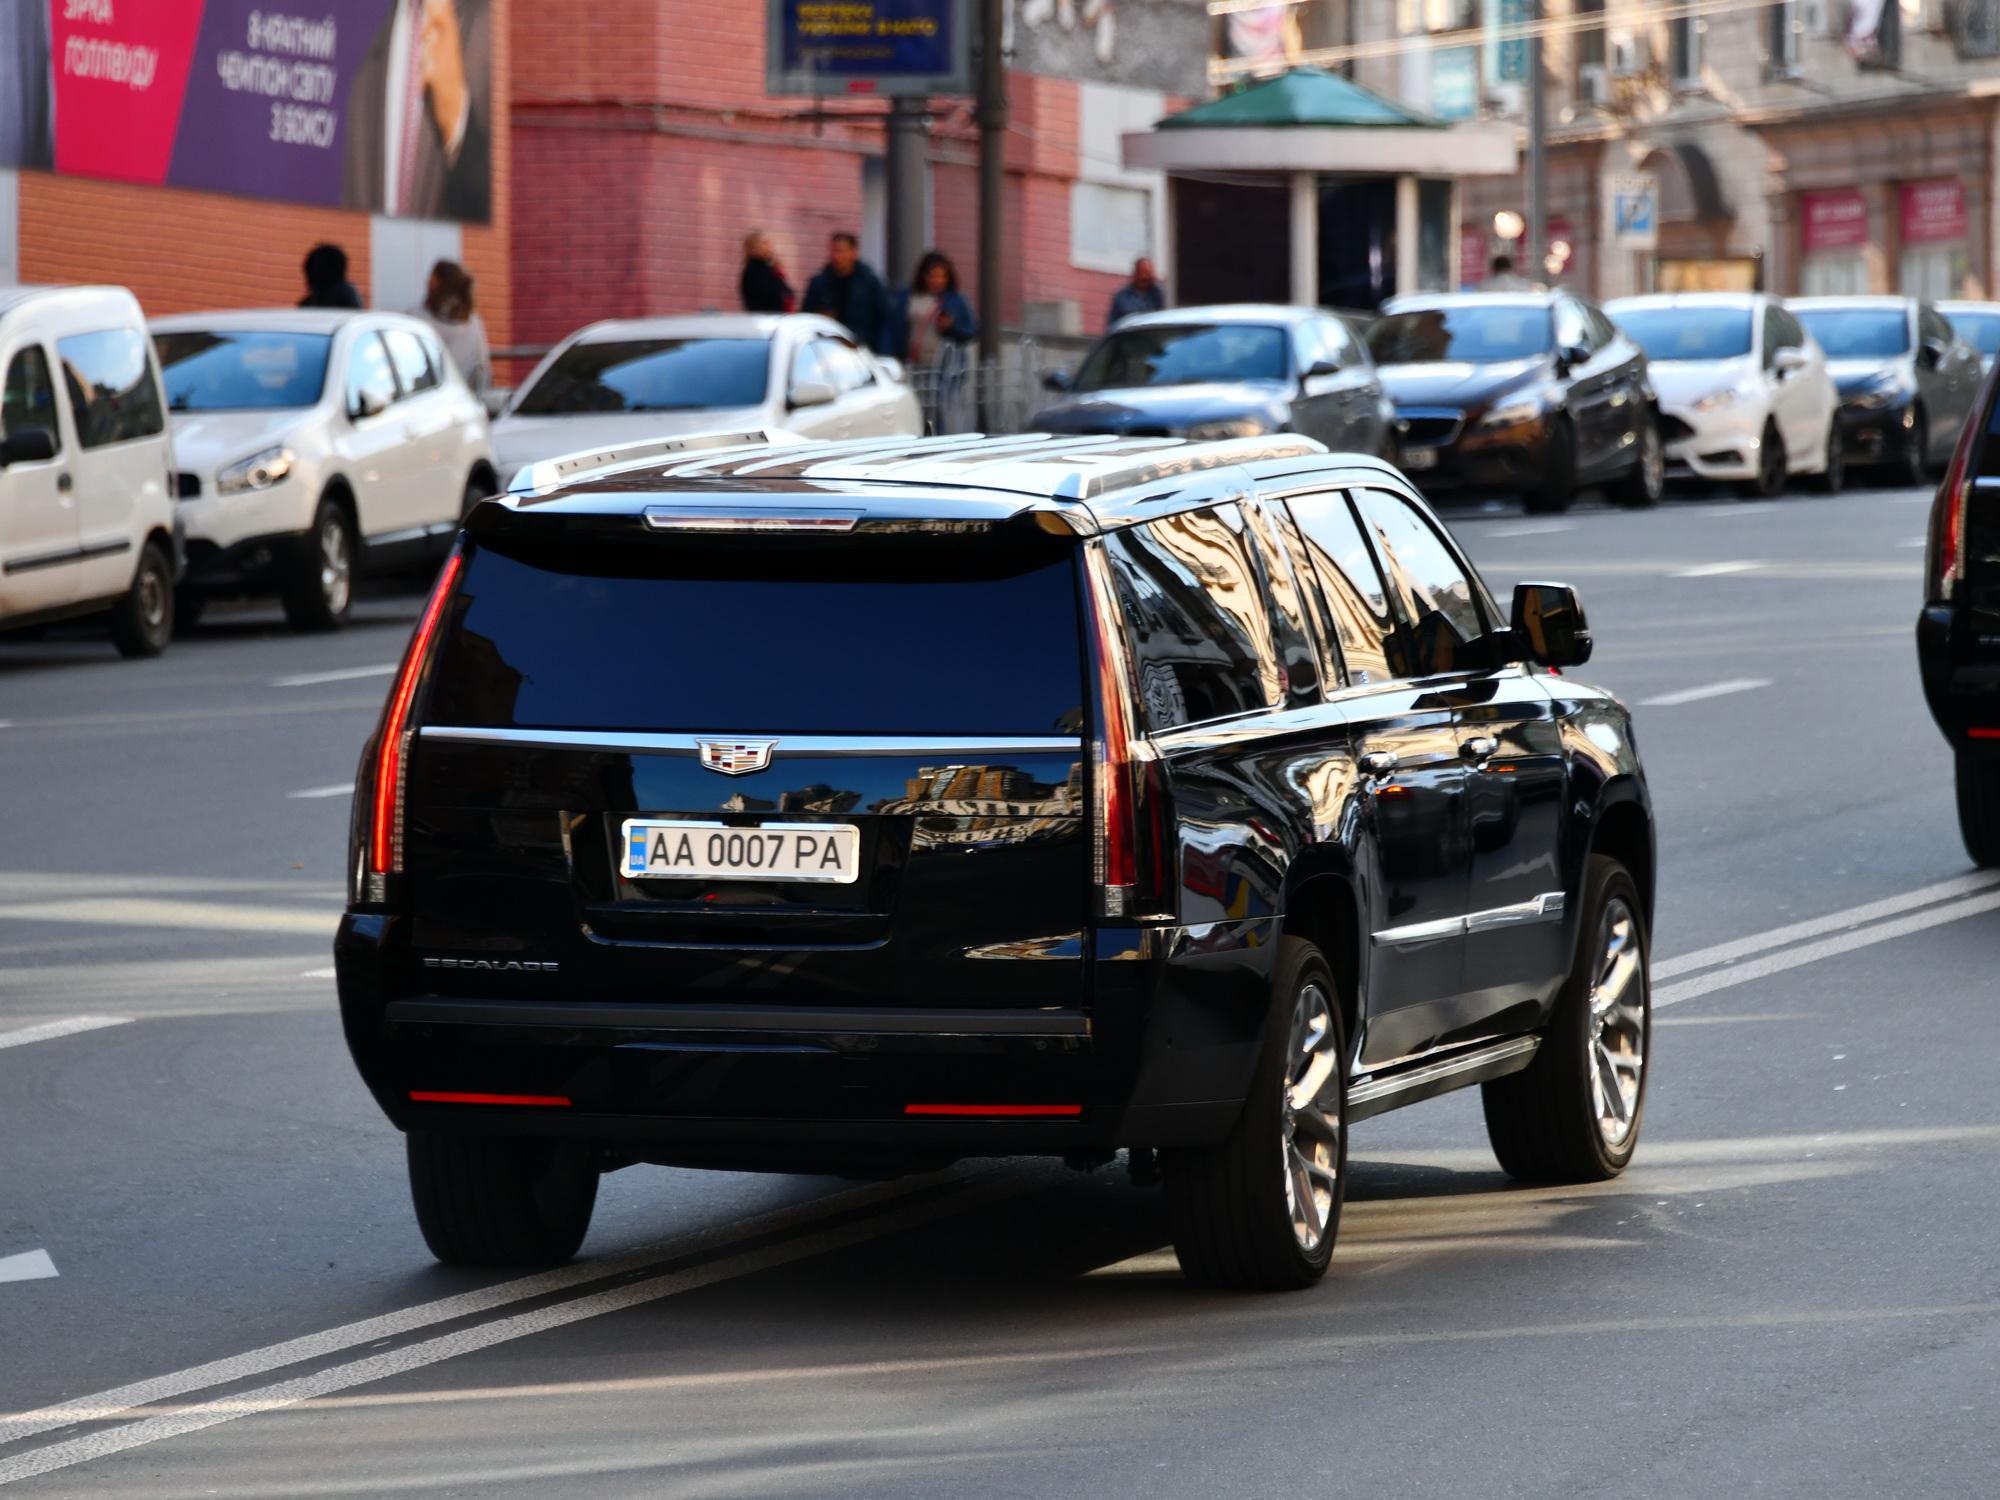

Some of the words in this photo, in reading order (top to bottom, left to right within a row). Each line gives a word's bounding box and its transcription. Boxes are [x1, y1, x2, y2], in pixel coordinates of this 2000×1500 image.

[649, 832, 694, 867] AA
[707, 833, 784, 869] 0007
[795, 835, 842, 870] PA
[631, 854, 645, 866] UA
[423, 957, 559, 972] ESCALADE
